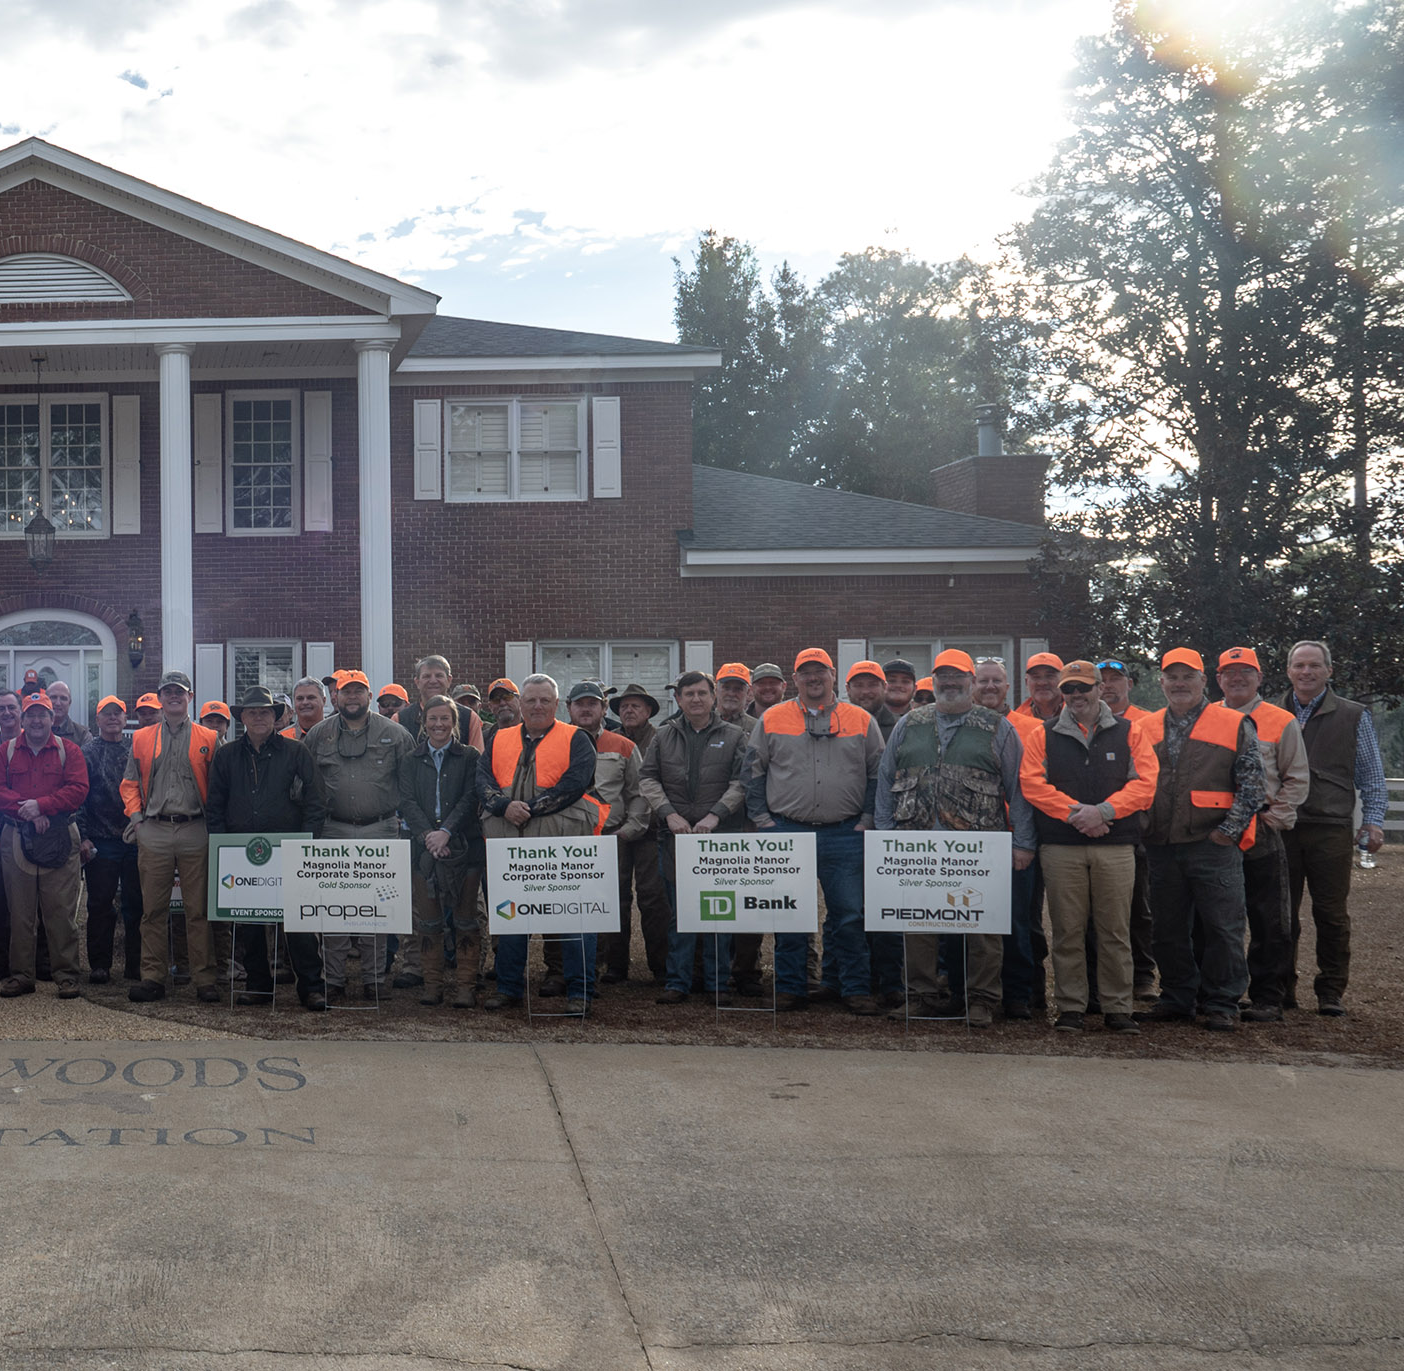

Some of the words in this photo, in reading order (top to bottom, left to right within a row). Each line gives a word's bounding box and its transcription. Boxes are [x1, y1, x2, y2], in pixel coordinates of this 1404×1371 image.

[697, 839, 750, 852] Thank
[756, 839, 794, 852] You!
[883, 839, 937, 852] Thank
[943, 840, 983, 853] You!
[301, 845, 350, 857] Thank
[355, 845, 390, 857] You!
[507, 846, 557, 859] Thank
[562, 845, 598, 858] You!
[302, 861, 350, 870] Magnolia
[353, 861, 387, 870] Manor
[699, 856, 751, 866] Magnolia
[754, 856, 790, 865] Manor
[884, 856, 937, 867] Magnolia
[941, 857, 979, 866] Manor
[509, 862, 557, 872] Magnolia
[561, 862, 595, 870] Manor
[692, 866, 750, 876] Corporate
[753, 866, 801, 875] Sponsor
[876, 866, 936, 877] Corporate
[940, 867, 990, 877] Sponsor
[296, 870, 350, 879] Corporate
[352, 870, 397, 879] Sponsor
[502, 872, 557, 882] Corporate
[560, 871, 605, 880] Sponsor
[235, 877, 283, 886] ONEDIGIT
[318, 881, 337, 889] Gold
[338, 881, 371, 890] Sponsor
[714, 878, 737, 886] Silver
[739, 878, 775, 886] Sponsor
[898, 879, 923, 887] Silver
[925, 879, 962, 888] Sponsor
[523, 884, 545, 892] Silver
[547, 884, 581, 892] Sponsor
[517, 902, 610, 915] ONEDIGITAL
[703, 896, 733, 915] TD
[744, 896, 797, 910] Bank
[254, 909, 283, 917] SPONSO
[881, 908, 984, 921] PIEDMONT
